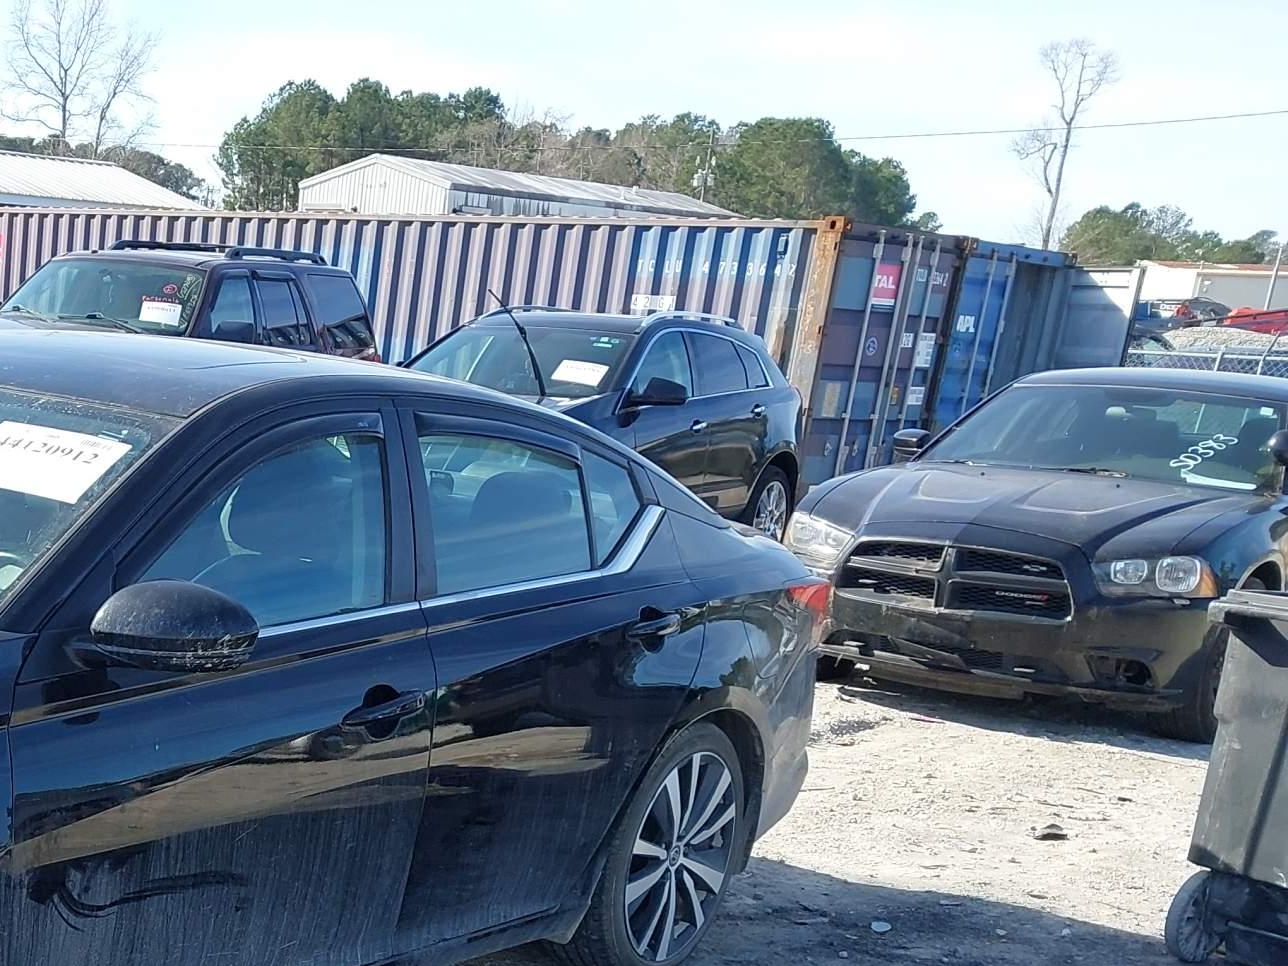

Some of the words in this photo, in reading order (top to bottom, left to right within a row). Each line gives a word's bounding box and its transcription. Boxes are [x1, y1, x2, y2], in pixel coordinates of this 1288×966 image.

[637, 259, 682, 274] TCLU
[874, 275, 896, 289] TAL
[956, 315, 976, 333] APL
